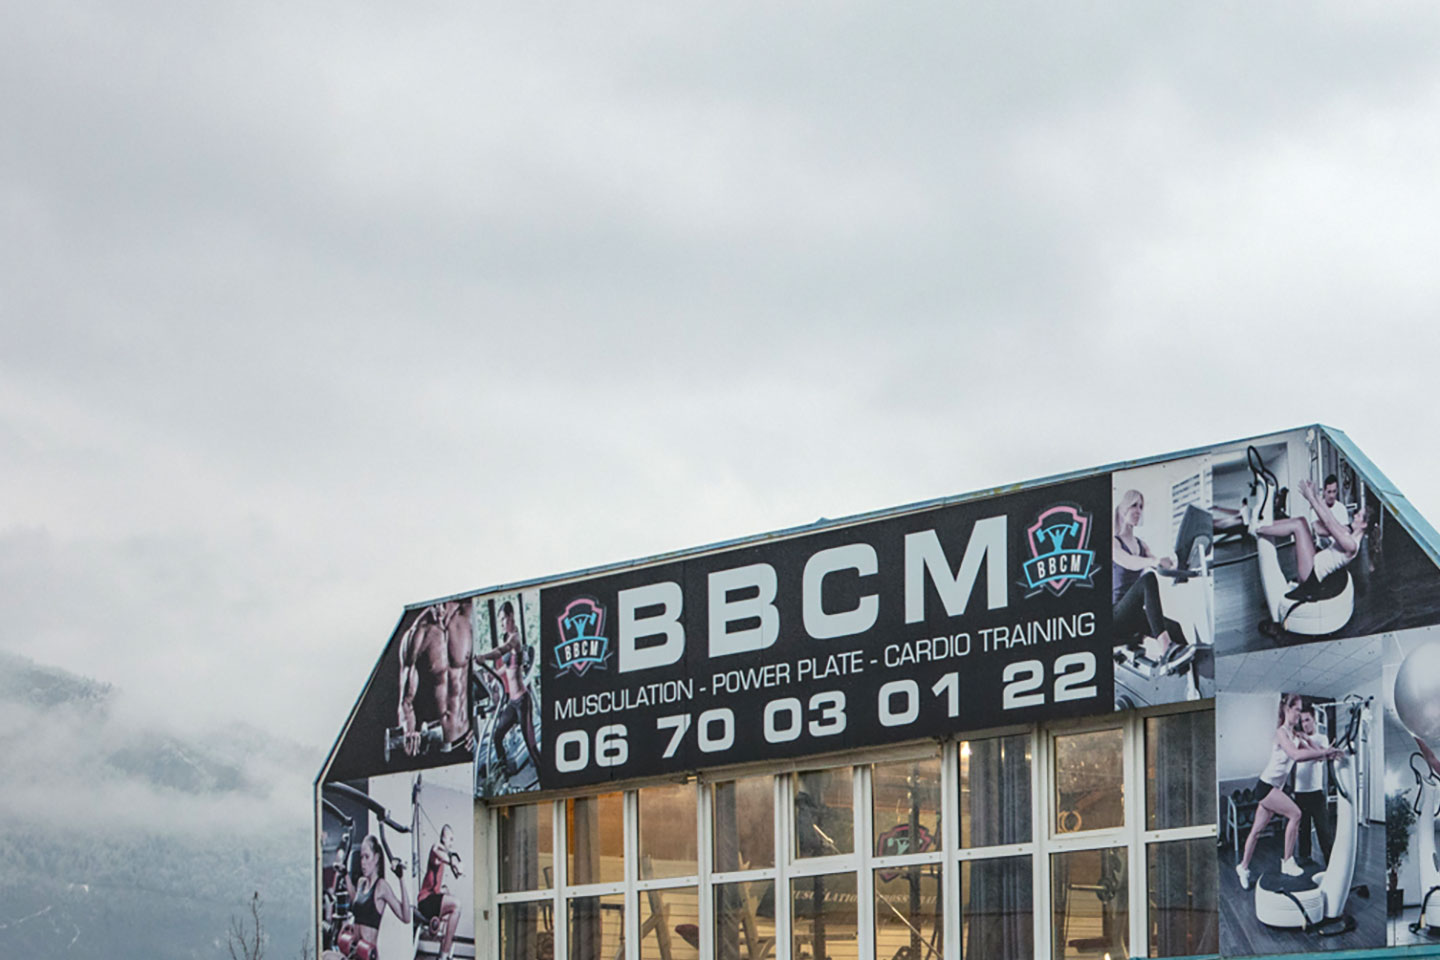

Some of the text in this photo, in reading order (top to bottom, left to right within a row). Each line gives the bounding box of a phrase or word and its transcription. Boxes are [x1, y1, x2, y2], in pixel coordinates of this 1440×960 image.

[618, 514, 1008, 673] BBCM
[1037, 554, 1081, 579] BBCM
[554, 679, 693, 720] MUSCULATION
[713, 664, 790, 695] POWER
[799, 651, 863, 681] PLATE
[884, 633, 971, 668] CARDIO
[979, 612, 1095, 650] TRAINING
[564, 640, 599, 661] BBCM
[555, 652, 1098, 773] 06 70 03 01 22
